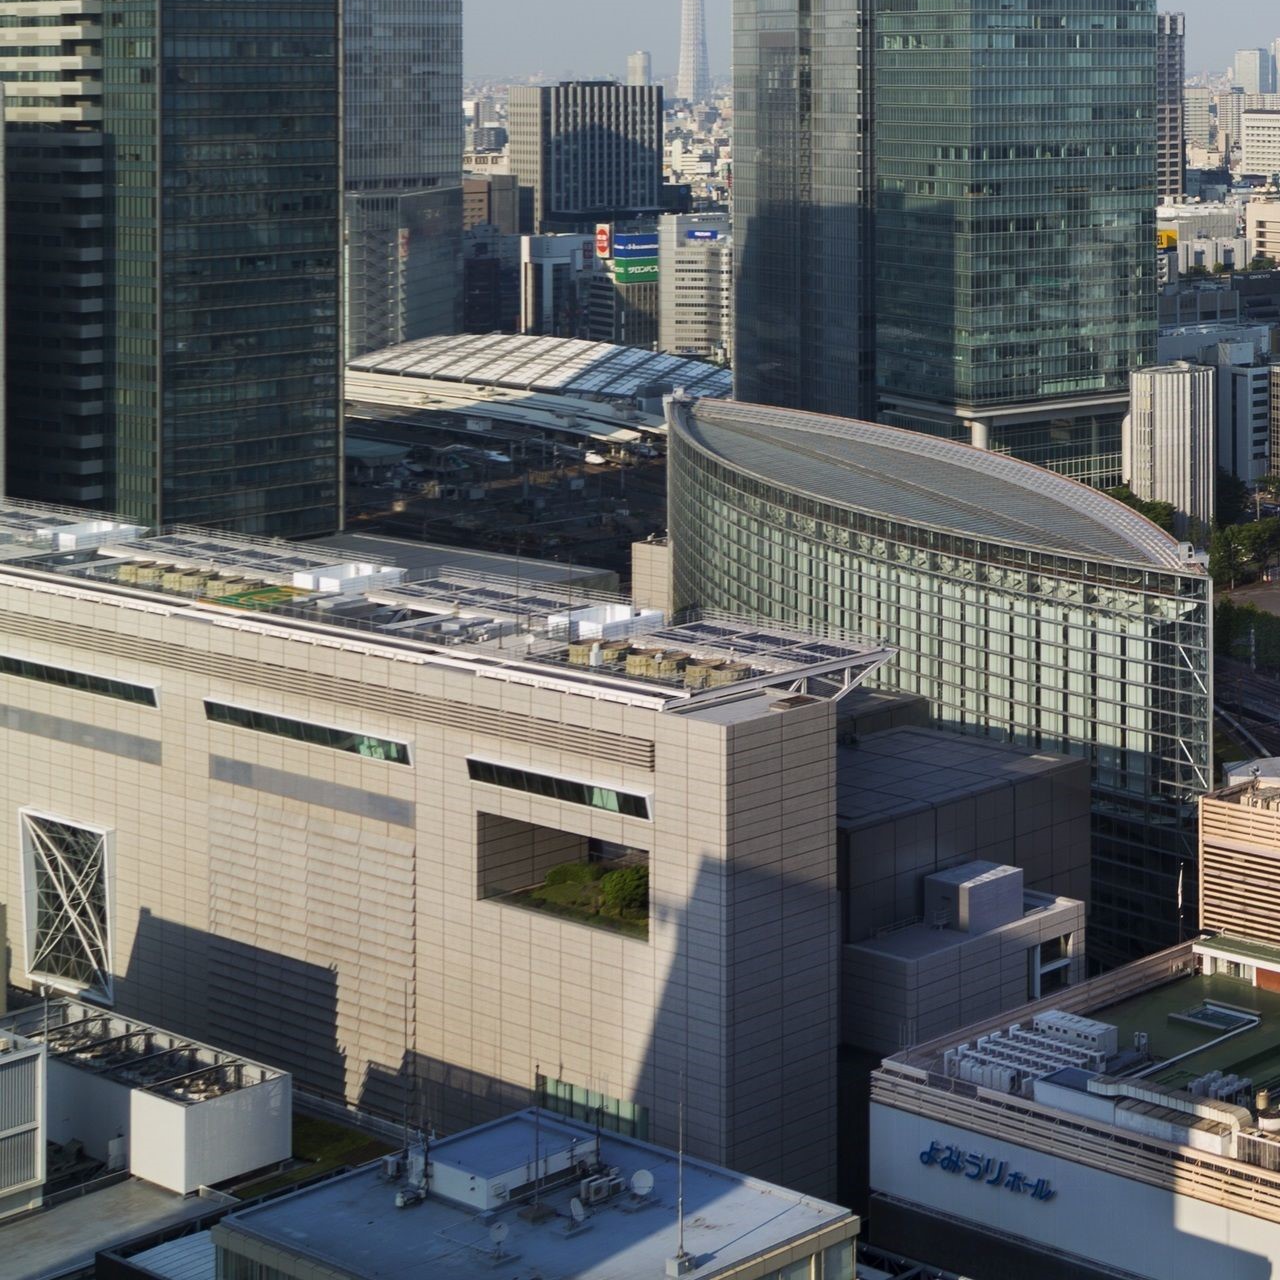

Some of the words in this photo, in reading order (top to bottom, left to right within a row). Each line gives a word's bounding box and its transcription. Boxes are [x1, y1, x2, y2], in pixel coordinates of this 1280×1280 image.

[920, 1140, 1056, 1201] よみうりホール
